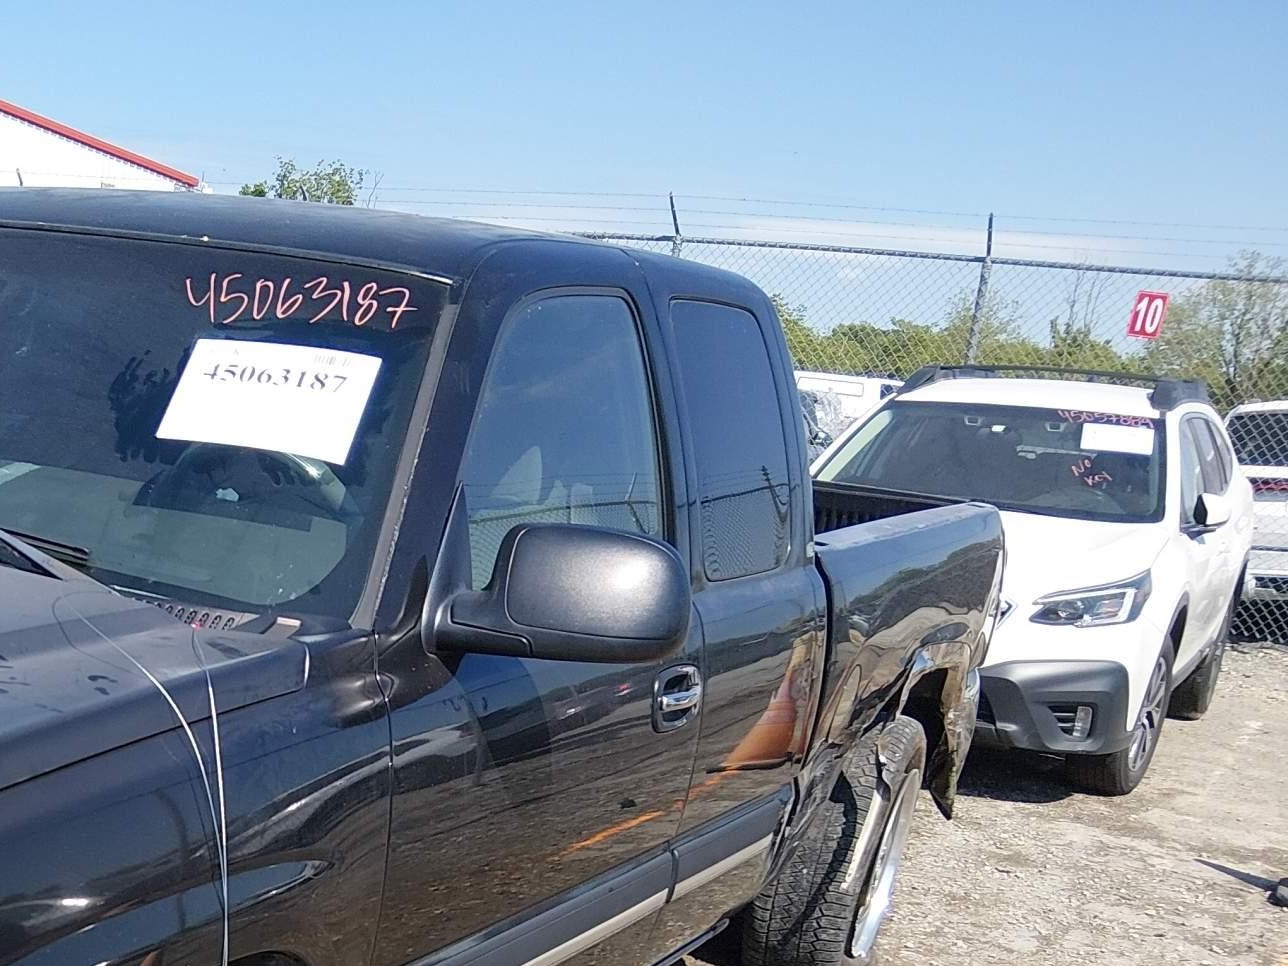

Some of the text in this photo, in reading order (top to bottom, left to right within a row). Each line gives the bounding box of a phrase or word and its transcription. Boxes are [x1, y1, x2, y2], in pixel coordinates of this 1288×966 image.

[185, 273, 418, 328] 45063187
[1134, 296, 1164, 334] 10
[203, 363, 347, 392] 45063187
